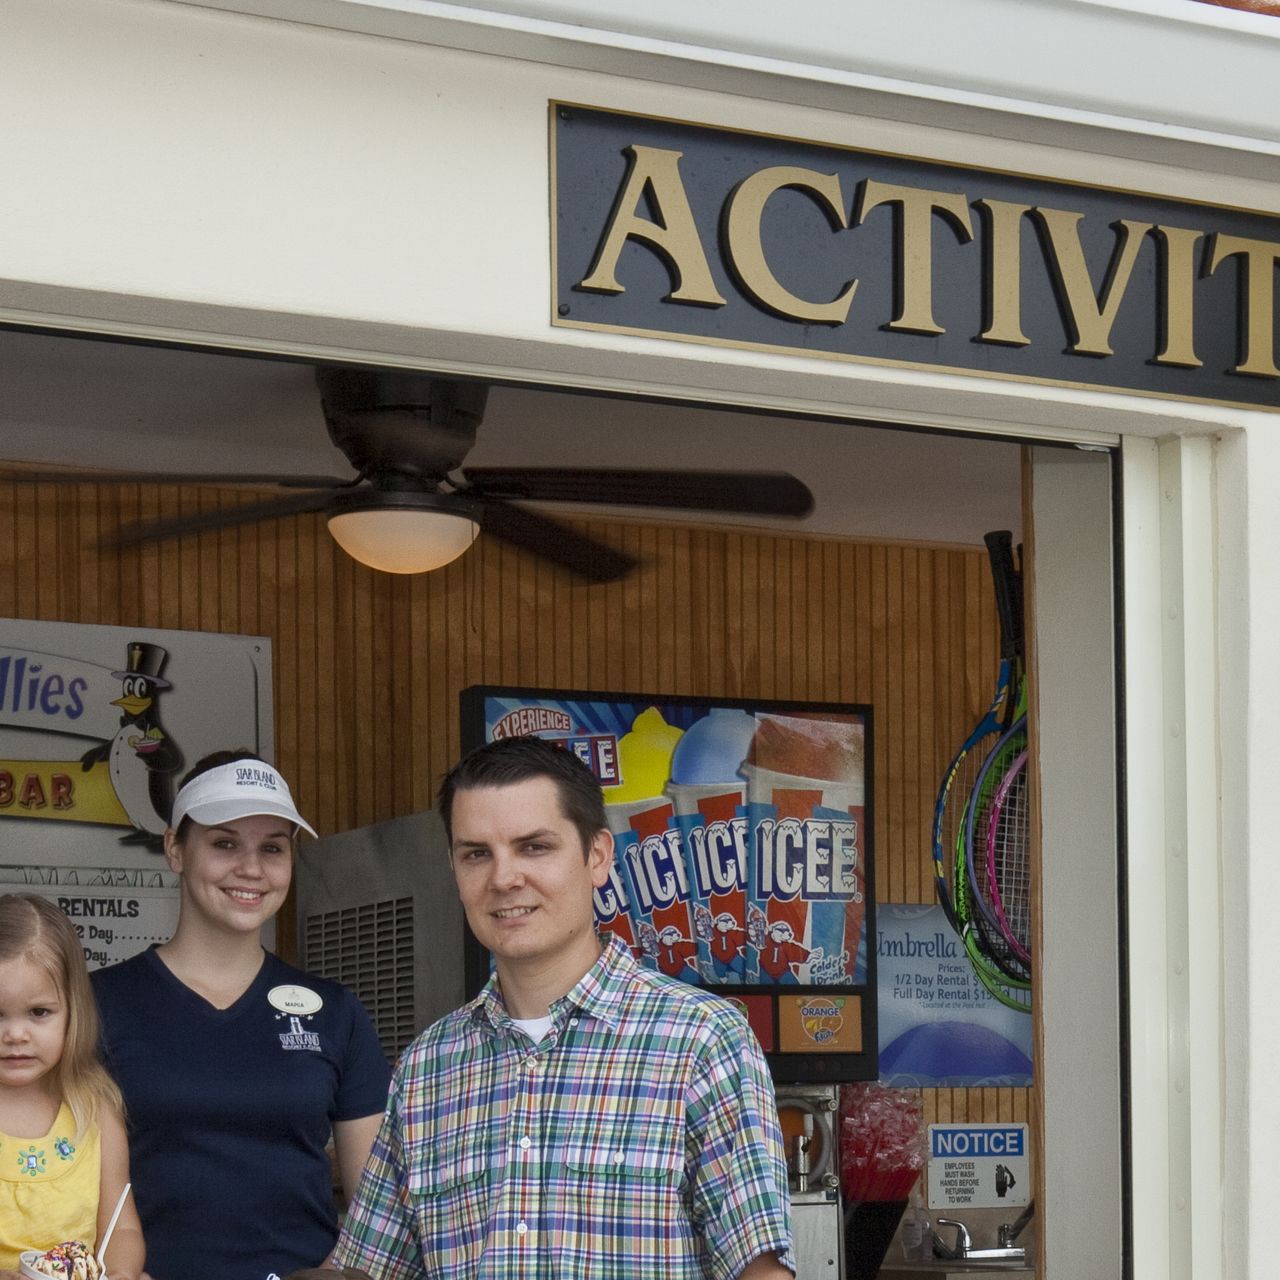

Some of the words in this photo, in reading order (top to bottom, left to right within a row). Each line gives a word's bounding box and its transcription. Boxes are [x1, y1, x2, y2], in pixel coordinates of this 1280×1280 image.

[494, 707, 570, 740] EXPERIENCE
[756, 818, 856, 898] ICEE
[58, 897, 139, 917] RENTALS
[938, 964, 965, 973] Prices:
[895, 974, 911, 985] 1/2
[915, 974, 934, 988] Day
[937, 974, 970, 986] Rental
[894, 988, 912, 999] Full
[916, 988, 934, 1001] Day
[938, 988, 970, 1000] Rental
[801, 1007, 839, 1017] ORANGE
[937, 1132, 1019, 1154] NOTICE
[944, 1162, 975, 1170] EMPLOYEES
[959, 1178, 980, 1186] BEFORE
[945, 1187, 975, 1195] RETURNING
